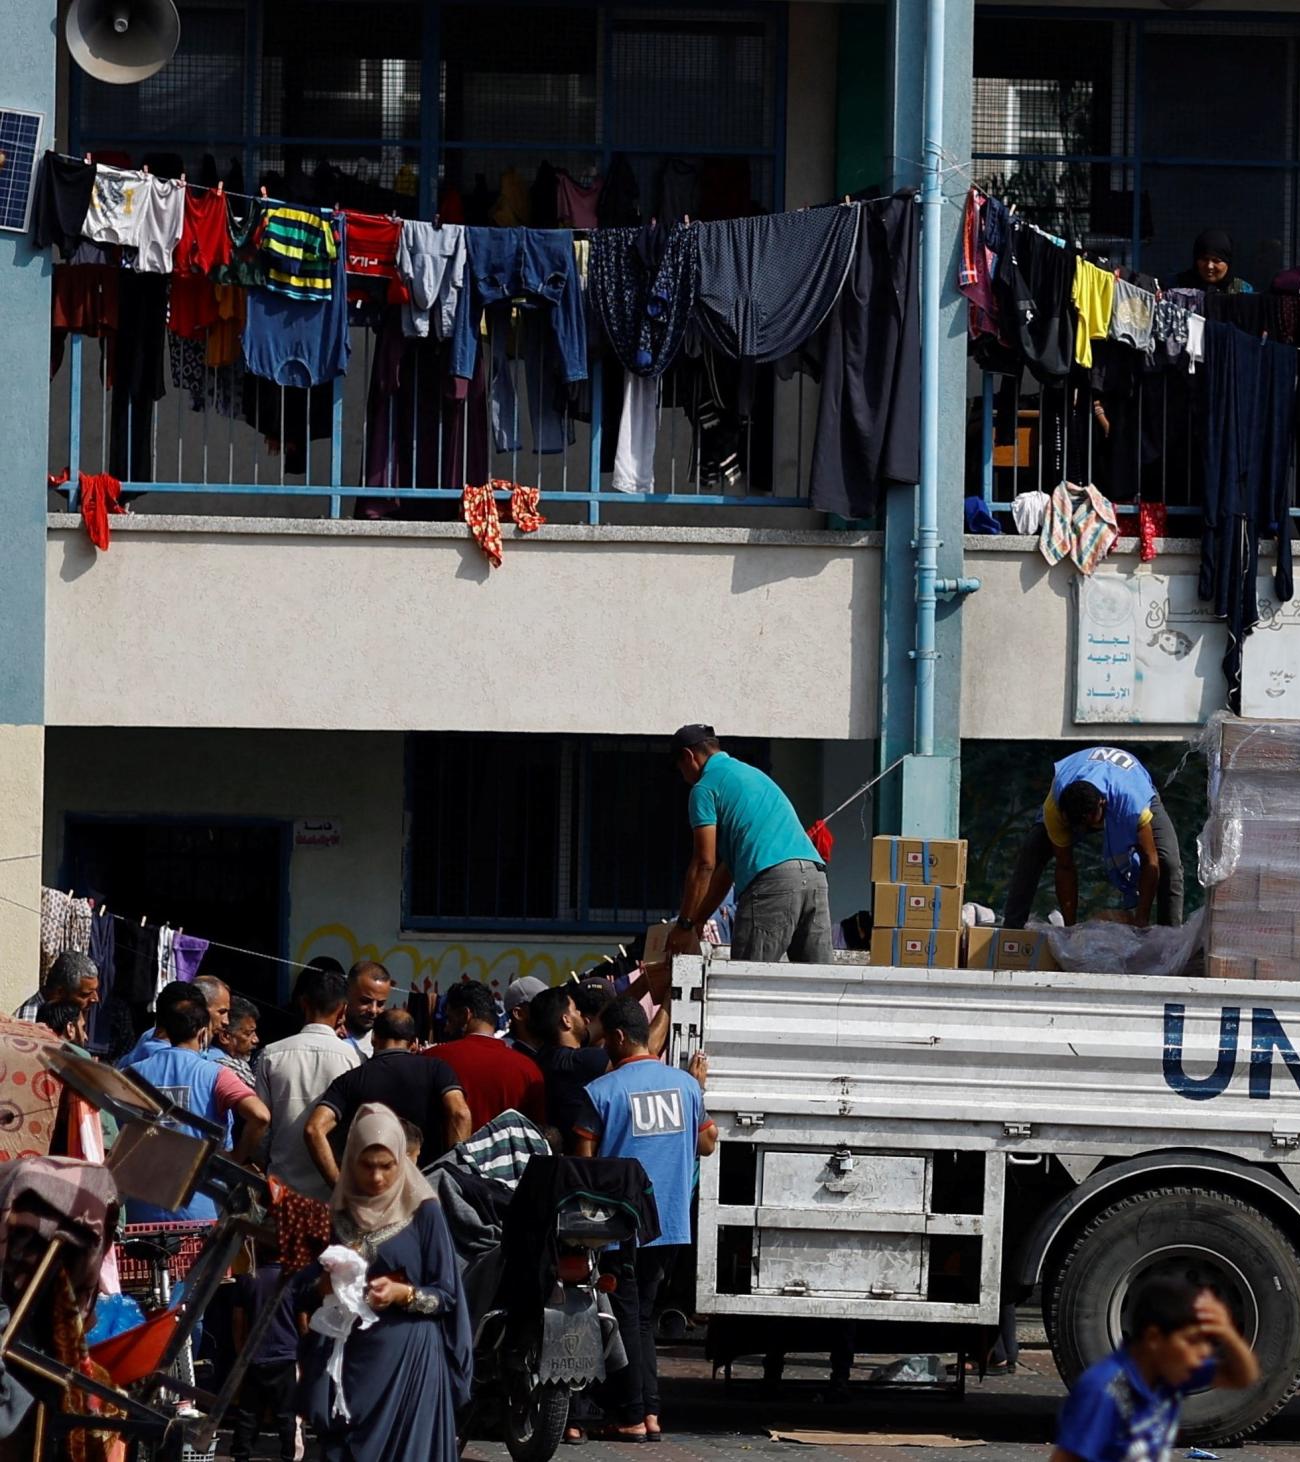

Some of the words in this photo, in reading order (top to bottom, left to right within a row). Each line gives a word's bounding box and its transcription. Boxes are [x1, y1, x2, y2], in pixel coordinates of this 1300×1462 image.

[1088, 632, 1130, 647] لجنة
[1087, 651, 1131, 665] التوجيه
[1091, 748, 1133, 768] UN
[633, 1093, 681, 1131] UN
